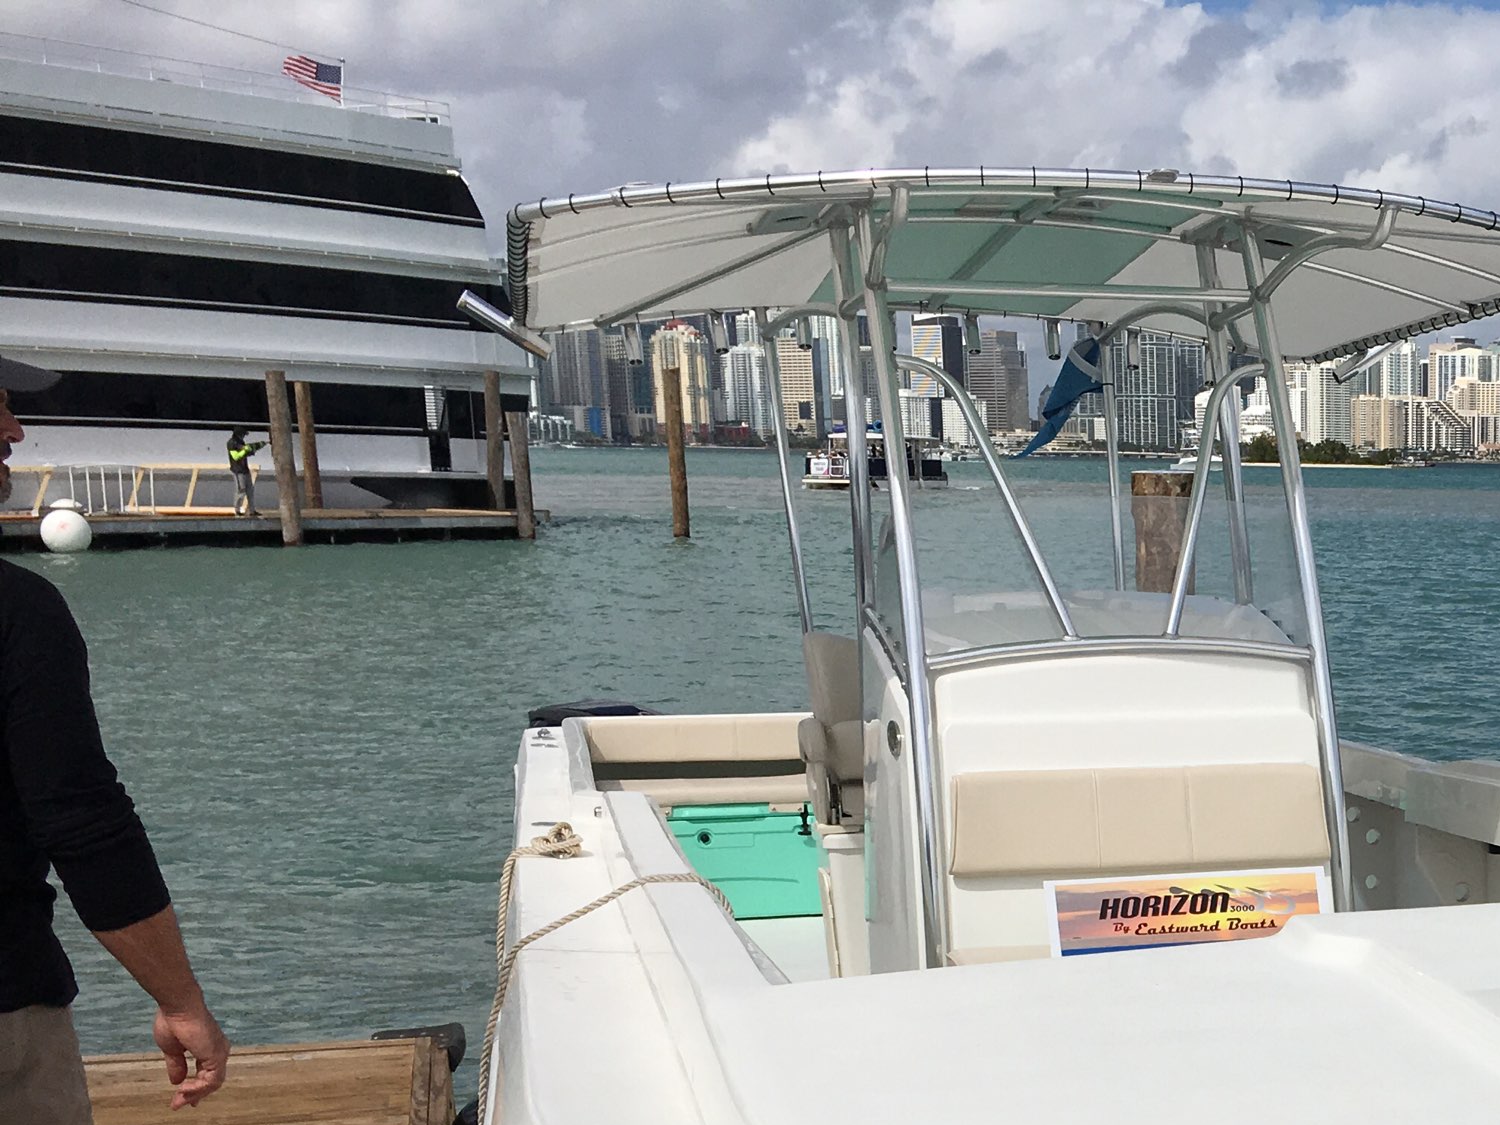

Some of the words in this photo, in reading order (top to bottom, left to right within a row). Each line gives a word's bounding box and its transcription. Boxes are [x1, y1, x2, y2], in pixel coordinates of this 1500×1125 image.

[1099, 891, 1230, 920] HORIZON
[1230, 904, 1255, 913] 3000
[1113, 922, 1131, 934] By
[1135, 920, 1221, 936] Eastward
[1226, 917, 1278, 931] Boats
